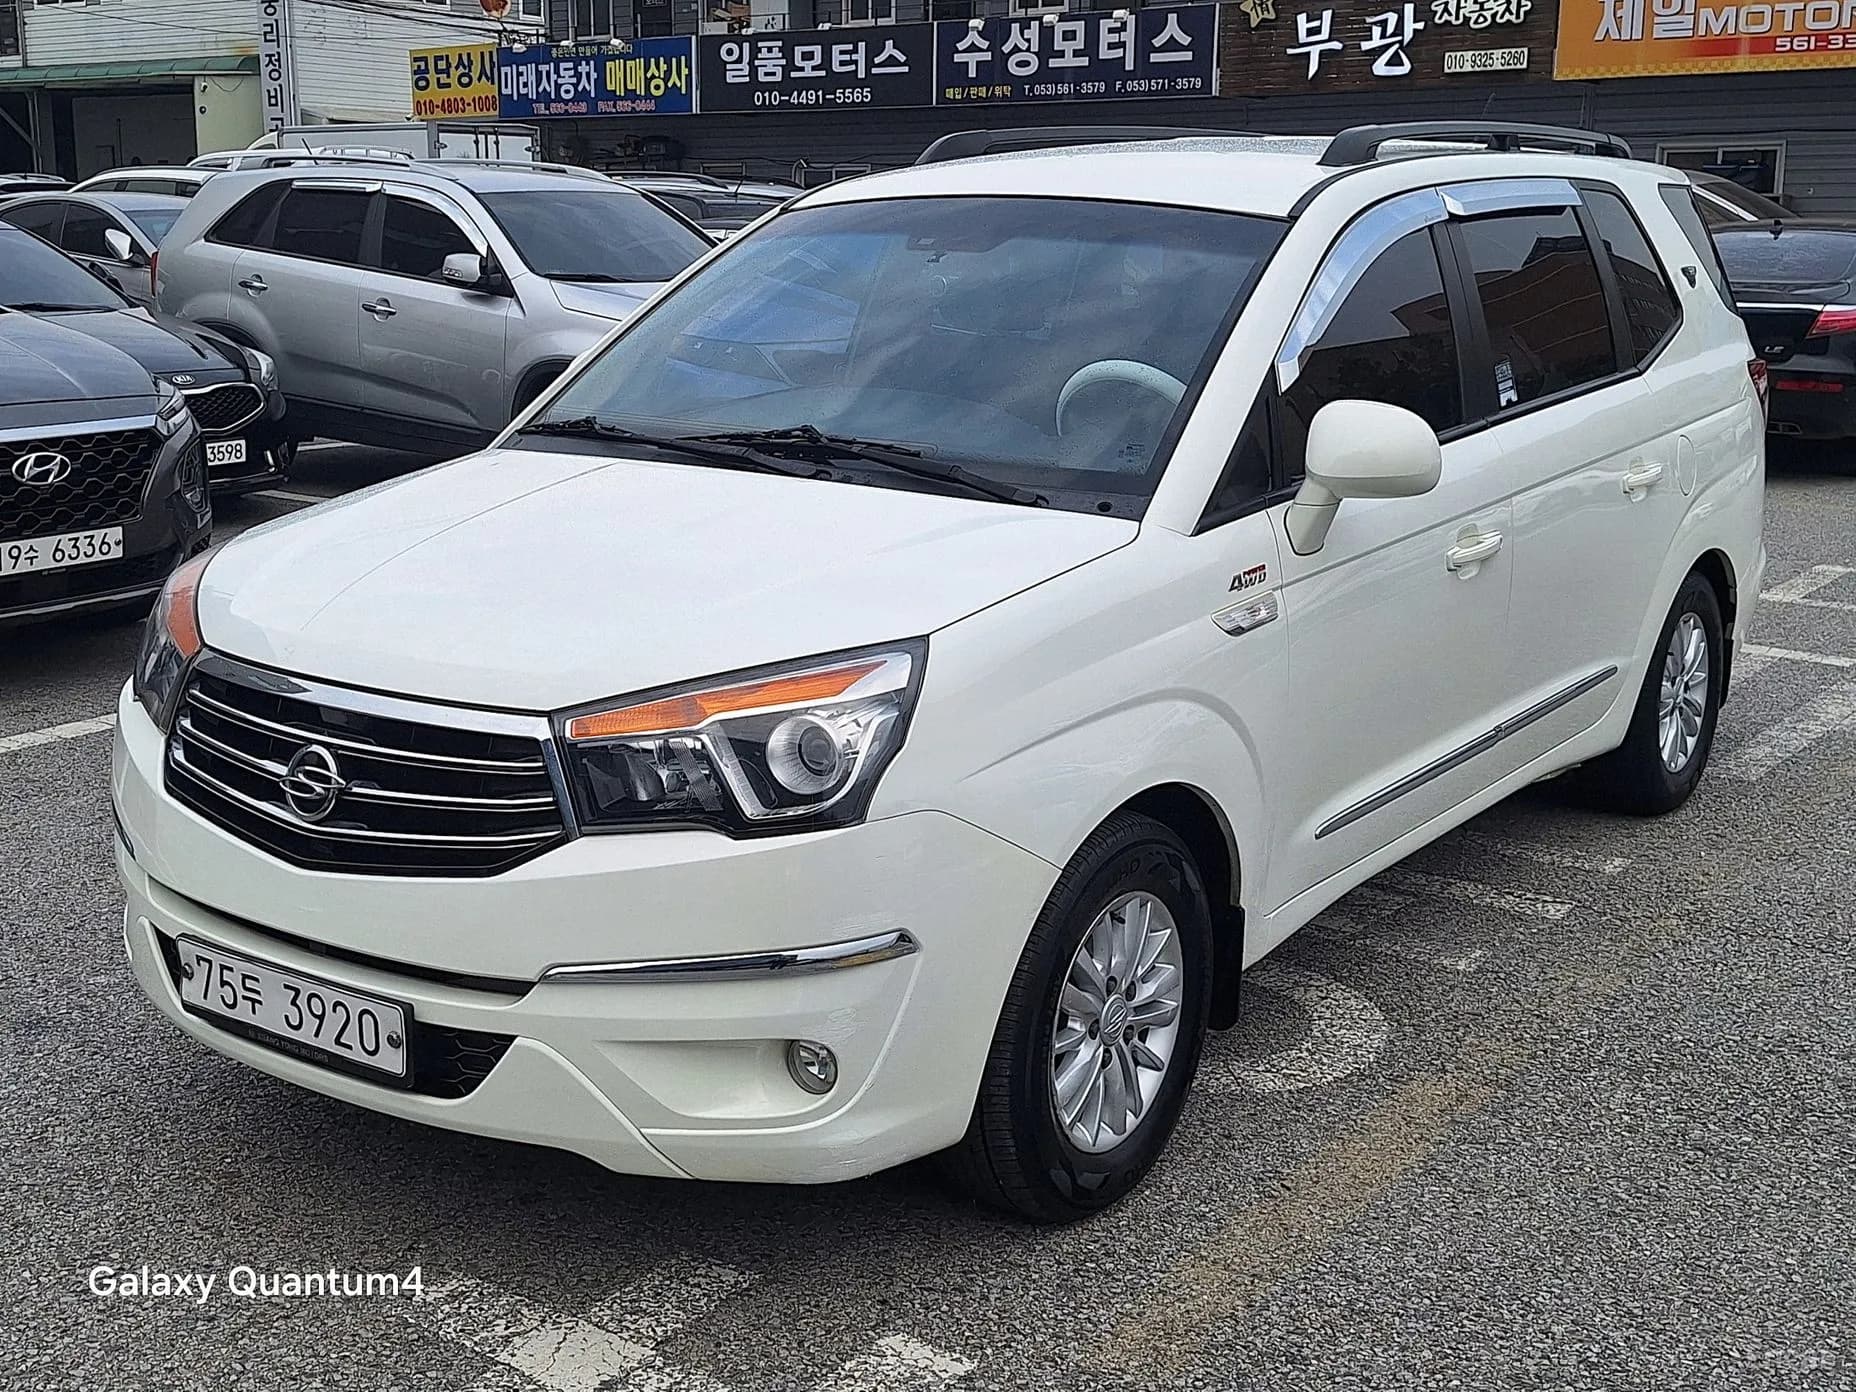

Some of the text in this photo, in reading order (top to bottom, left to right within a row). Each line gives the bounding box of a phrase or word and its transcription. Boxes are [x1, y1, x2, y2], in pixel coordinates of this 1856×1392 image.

[720, 39, 910, 83] 일품모터스
[953, 13, 1193, 78] 수성모터스
[413, 50, 496, 91] 공단상사
[500, 56, 689, 101] 미래자동차 매매상사
[415, 94, 498, 116] 010-4803-1008
[754, 88, 871, 106] 010-4491-5565
[207, 443, 243, 463] 3598
[52, 532, 112, 564] 6336
[1228, 564, 1266, 592] 4WD
[195, 954, 381, 1057] 75두 3920
